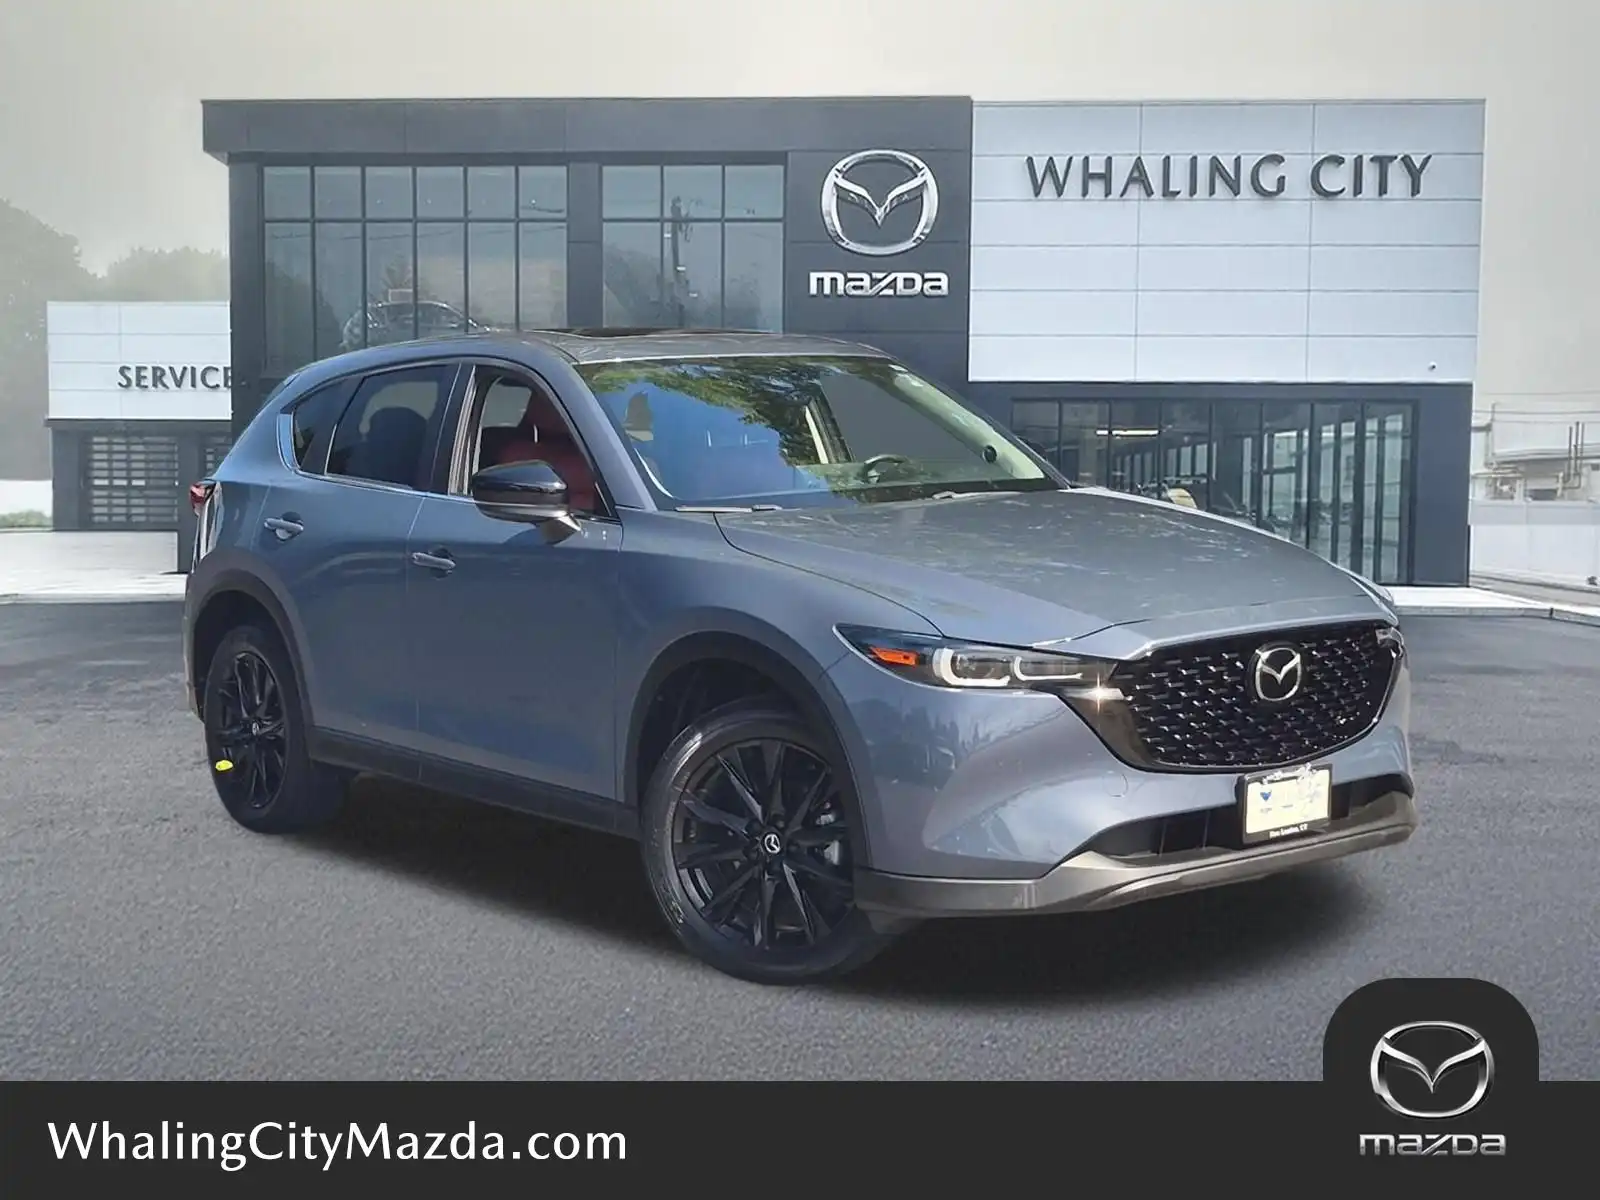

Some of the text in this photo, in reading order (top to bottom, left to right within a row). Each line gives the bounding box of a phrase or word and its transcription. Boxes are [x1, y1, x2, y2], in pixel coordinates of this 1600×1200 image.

[1025, 154, 1432, 198] WHALING CITY
[809, 271, 949, 297] mazda
[117, 365, 232, 390] SERVICE
